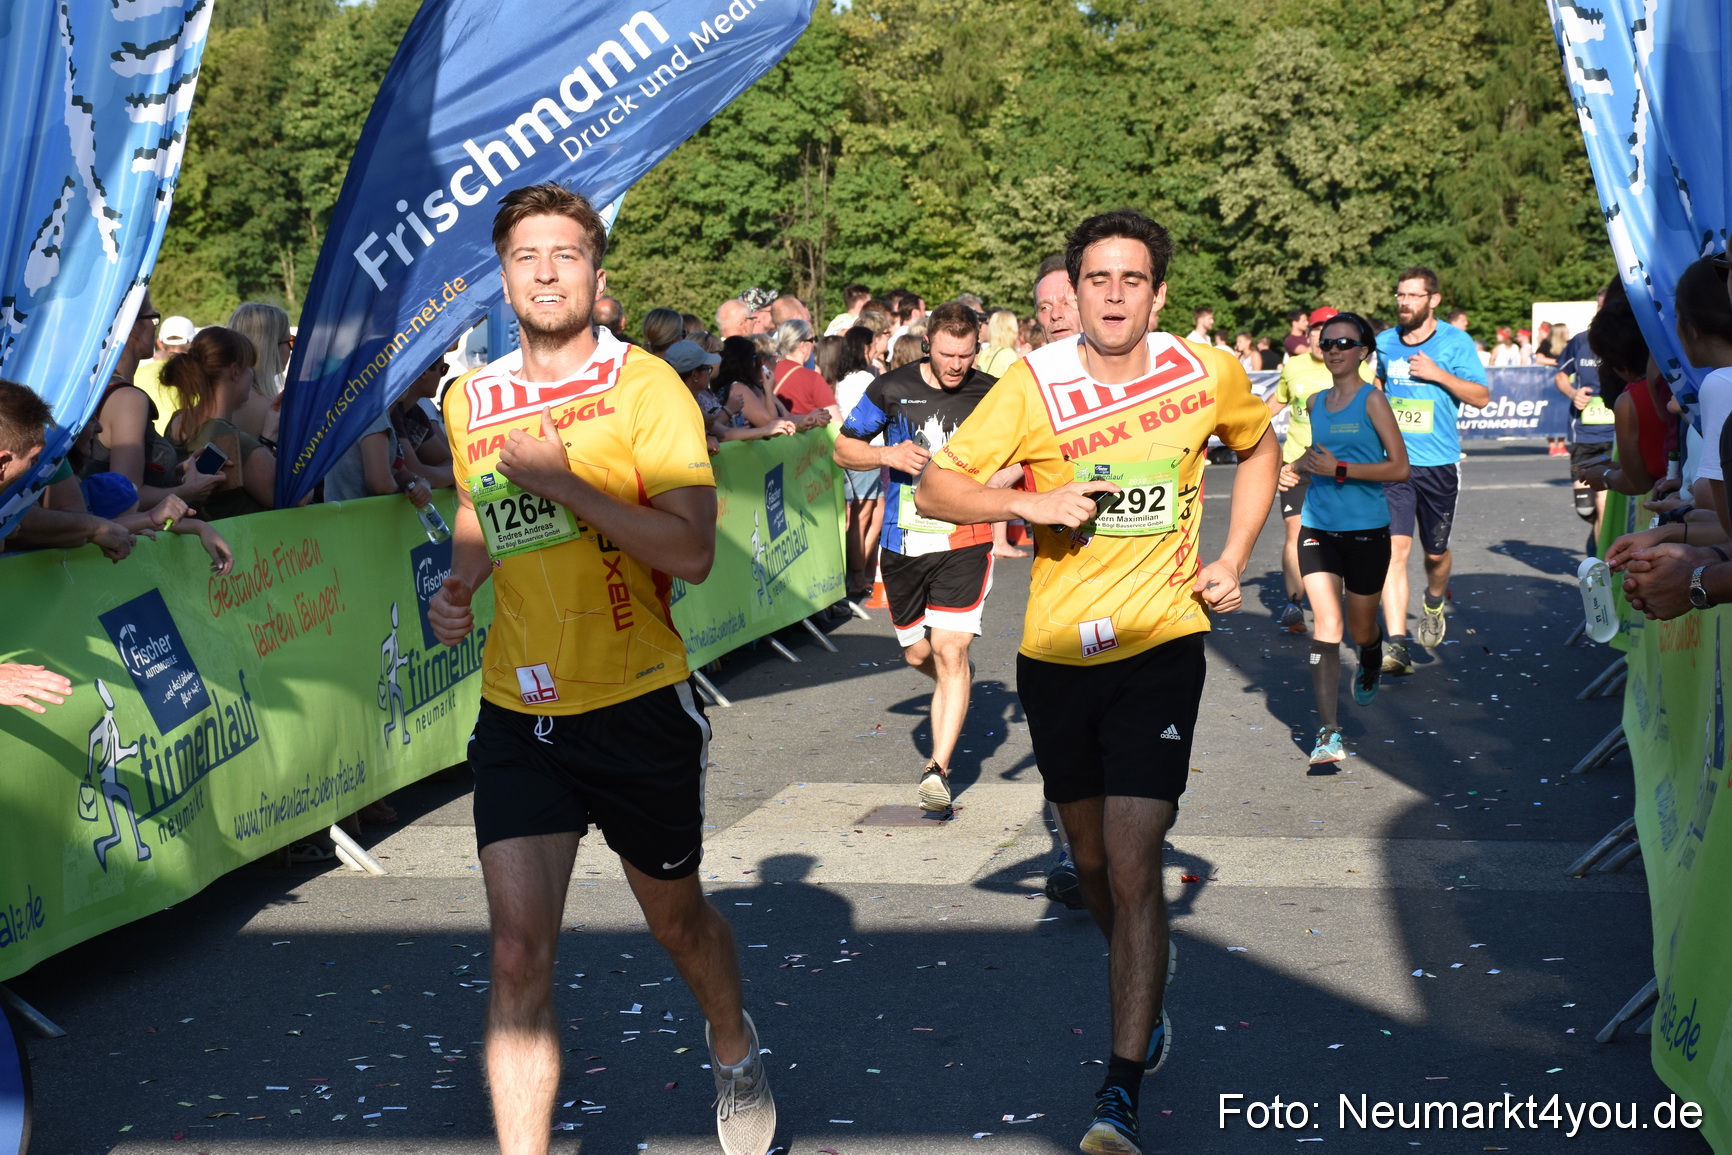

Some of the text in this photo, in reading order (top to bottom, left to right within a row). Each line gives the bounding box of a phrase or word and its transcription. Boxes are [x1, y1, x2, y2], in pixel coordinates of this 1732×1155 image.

[559, 95, 639, 162] Druck
[638, 44, 692, 98] und
[353, 10, 670, 292] Frischmann
[292, 276, 467, 475] www.frischmann-net.de
[1060, 390, 1215, 462] MAX BÖGL
[1397, 410, 1422, 424] 792
[485, 493, 557, 534] 1264
[498, 522, 554, 543] Endres Andreas
[517, 533, 544, 545] Bauservice
[544, 529, 561, 538] GmbH
[1117, 514, 1159, 523] Maximilian
[208, 538, 323, 618] Gesunde Firmen
[247, 567, 345, 659] laufen länger!
[130, 634, 172, 669] Fischer
[145, 654, 178, 680] AUTOMOBILE
[408, 622, 492, 708] firmenla
[139, 668, 260, 812] firmenlauf
[415, 689, 456, 734] neumarkt
[158, 786, 204, 845] neumarkt
